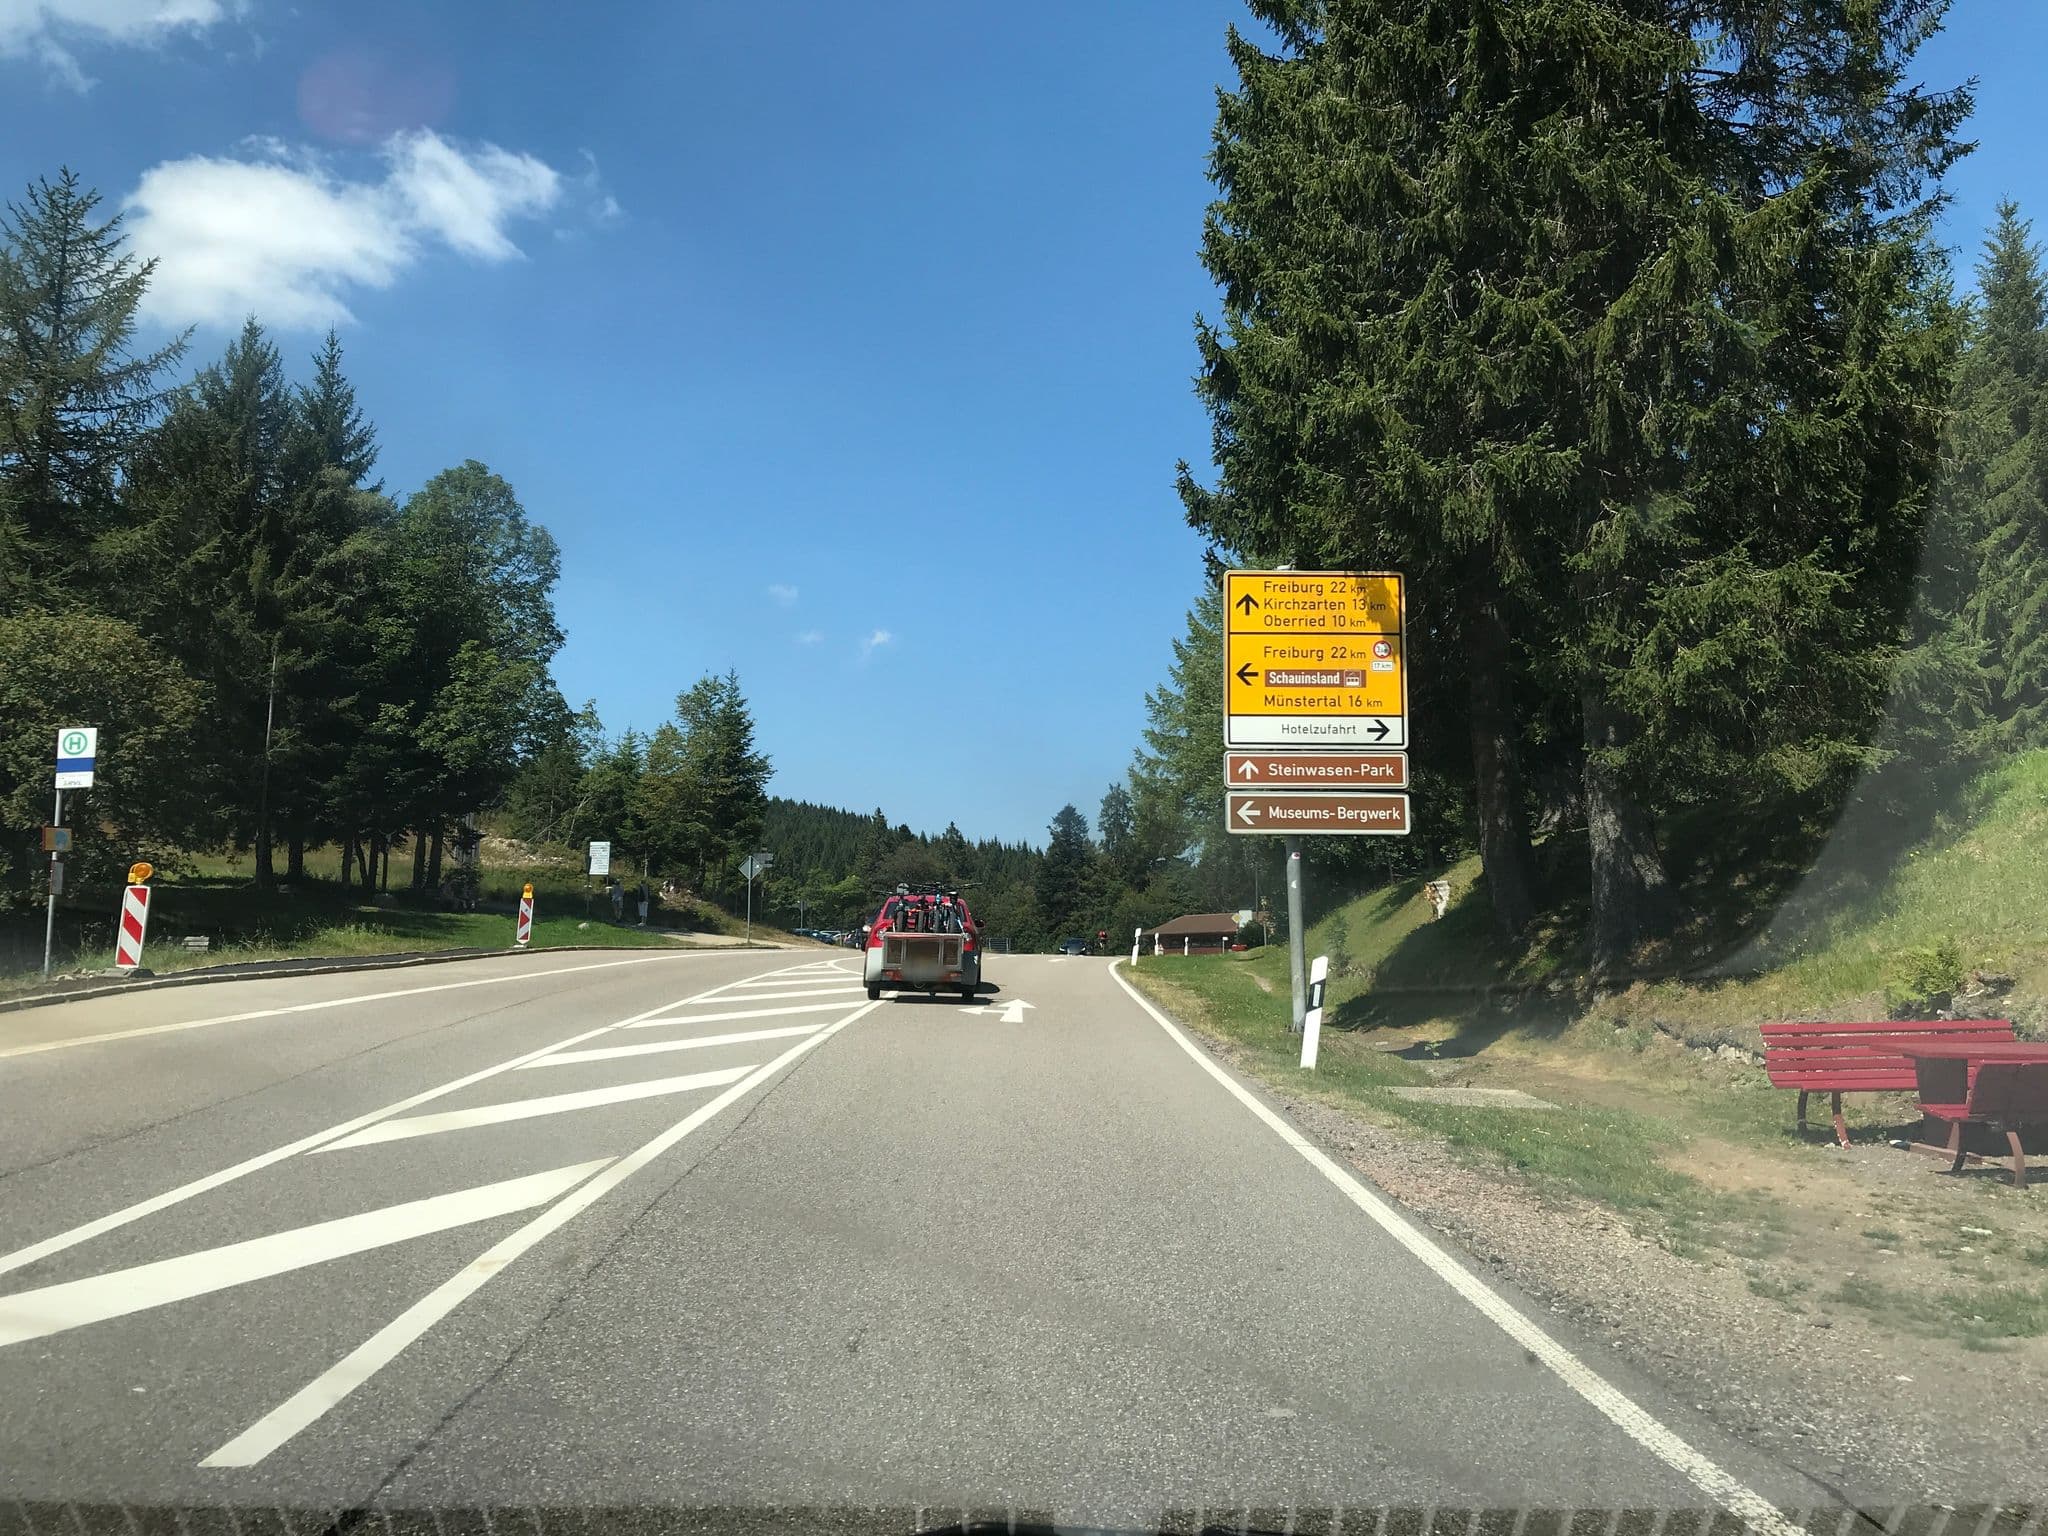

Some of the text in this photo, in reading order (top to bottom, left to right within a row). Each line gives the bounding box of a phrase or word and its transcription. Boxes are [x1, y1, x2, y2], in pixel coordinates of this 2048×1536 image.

[1264, 581, 1366, 595] Freiburg 22 km
[1264, 599, 1385, 610] Kirchzarten 13 km
[1264, 615, 1365, 627] Oberried 10 km
[1264, 646, 1366, 661] Freiburg 22 km
[1269, 672, 1340, 684] Schauinsland
[1264, 695, 1382, 707] Münstertal 16 km
[1282, 724, 1356, 735] Hotelzufahrt
[1268, 763, 1394, 776] Steinwasen-Park
